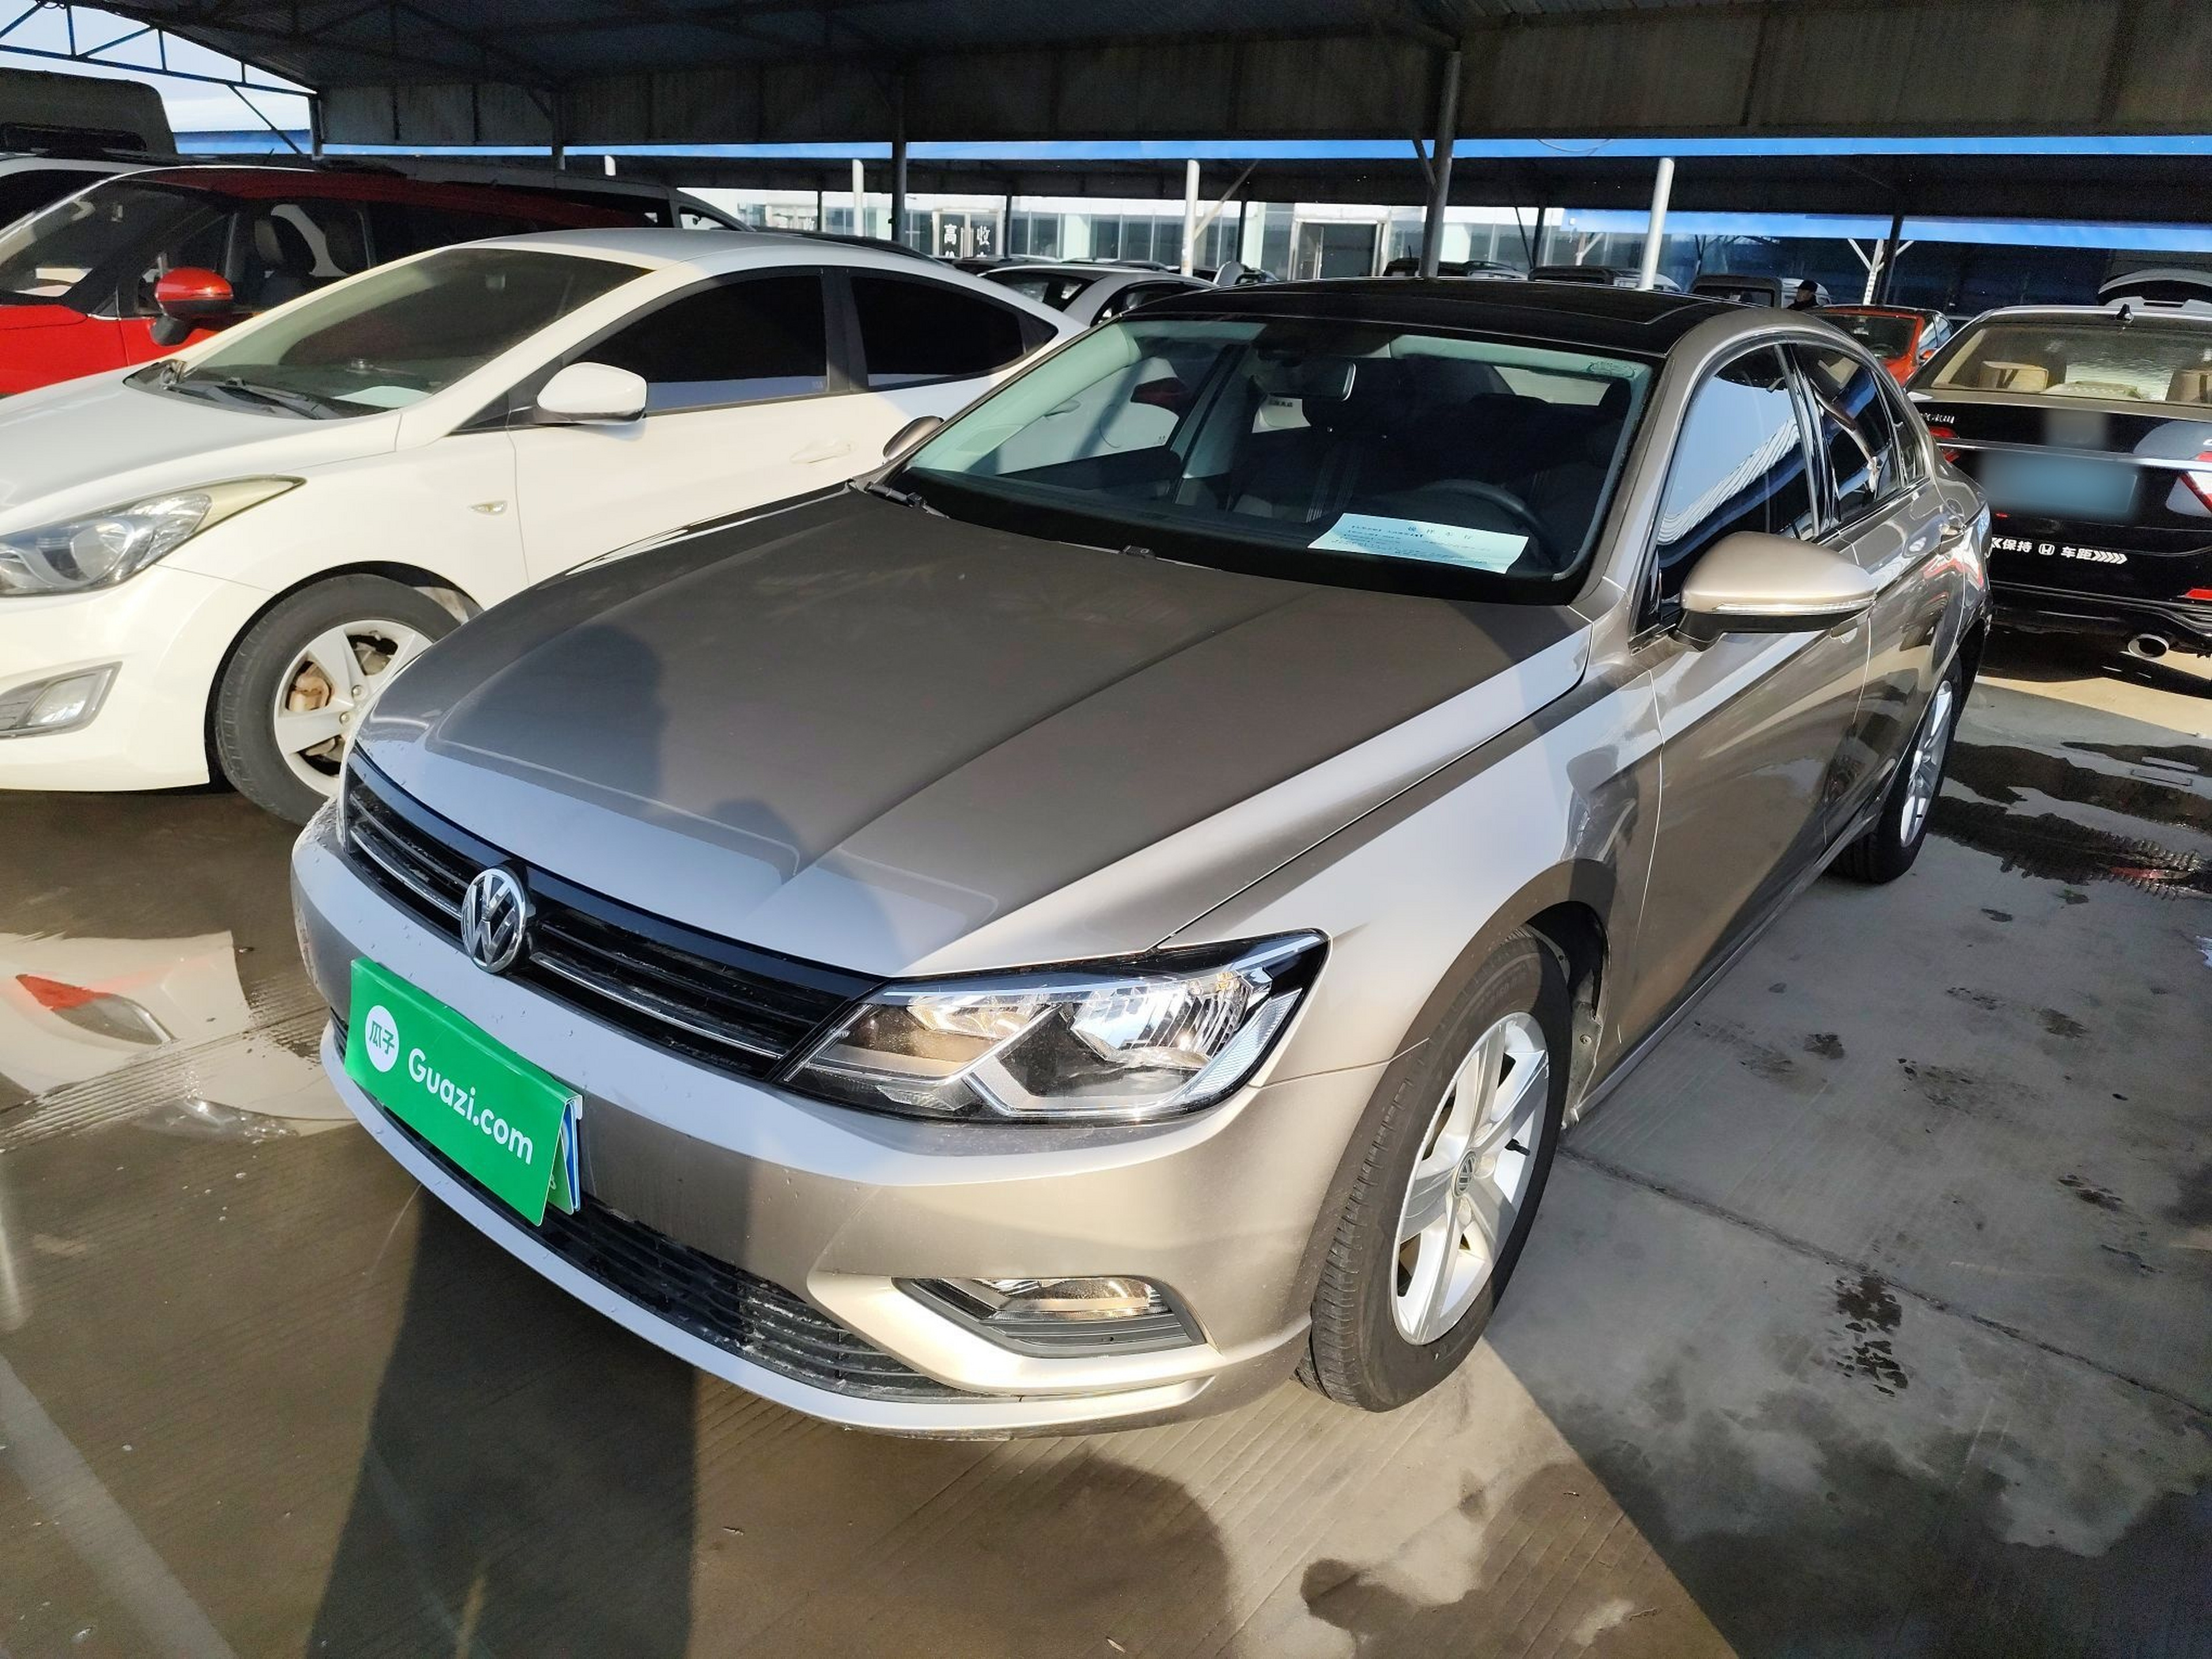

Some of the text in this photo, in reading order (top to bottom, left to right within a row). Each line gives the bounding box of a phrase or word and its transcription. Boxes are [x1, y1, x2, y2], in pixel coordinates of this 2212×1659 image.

[2002, 538, 2033, 553] 保持
[2061, 546, 2093, 560] 车距
[369, 1020, 395, 1055] 瓜子
[408, 1048, 533, 1165] Guazi.com
